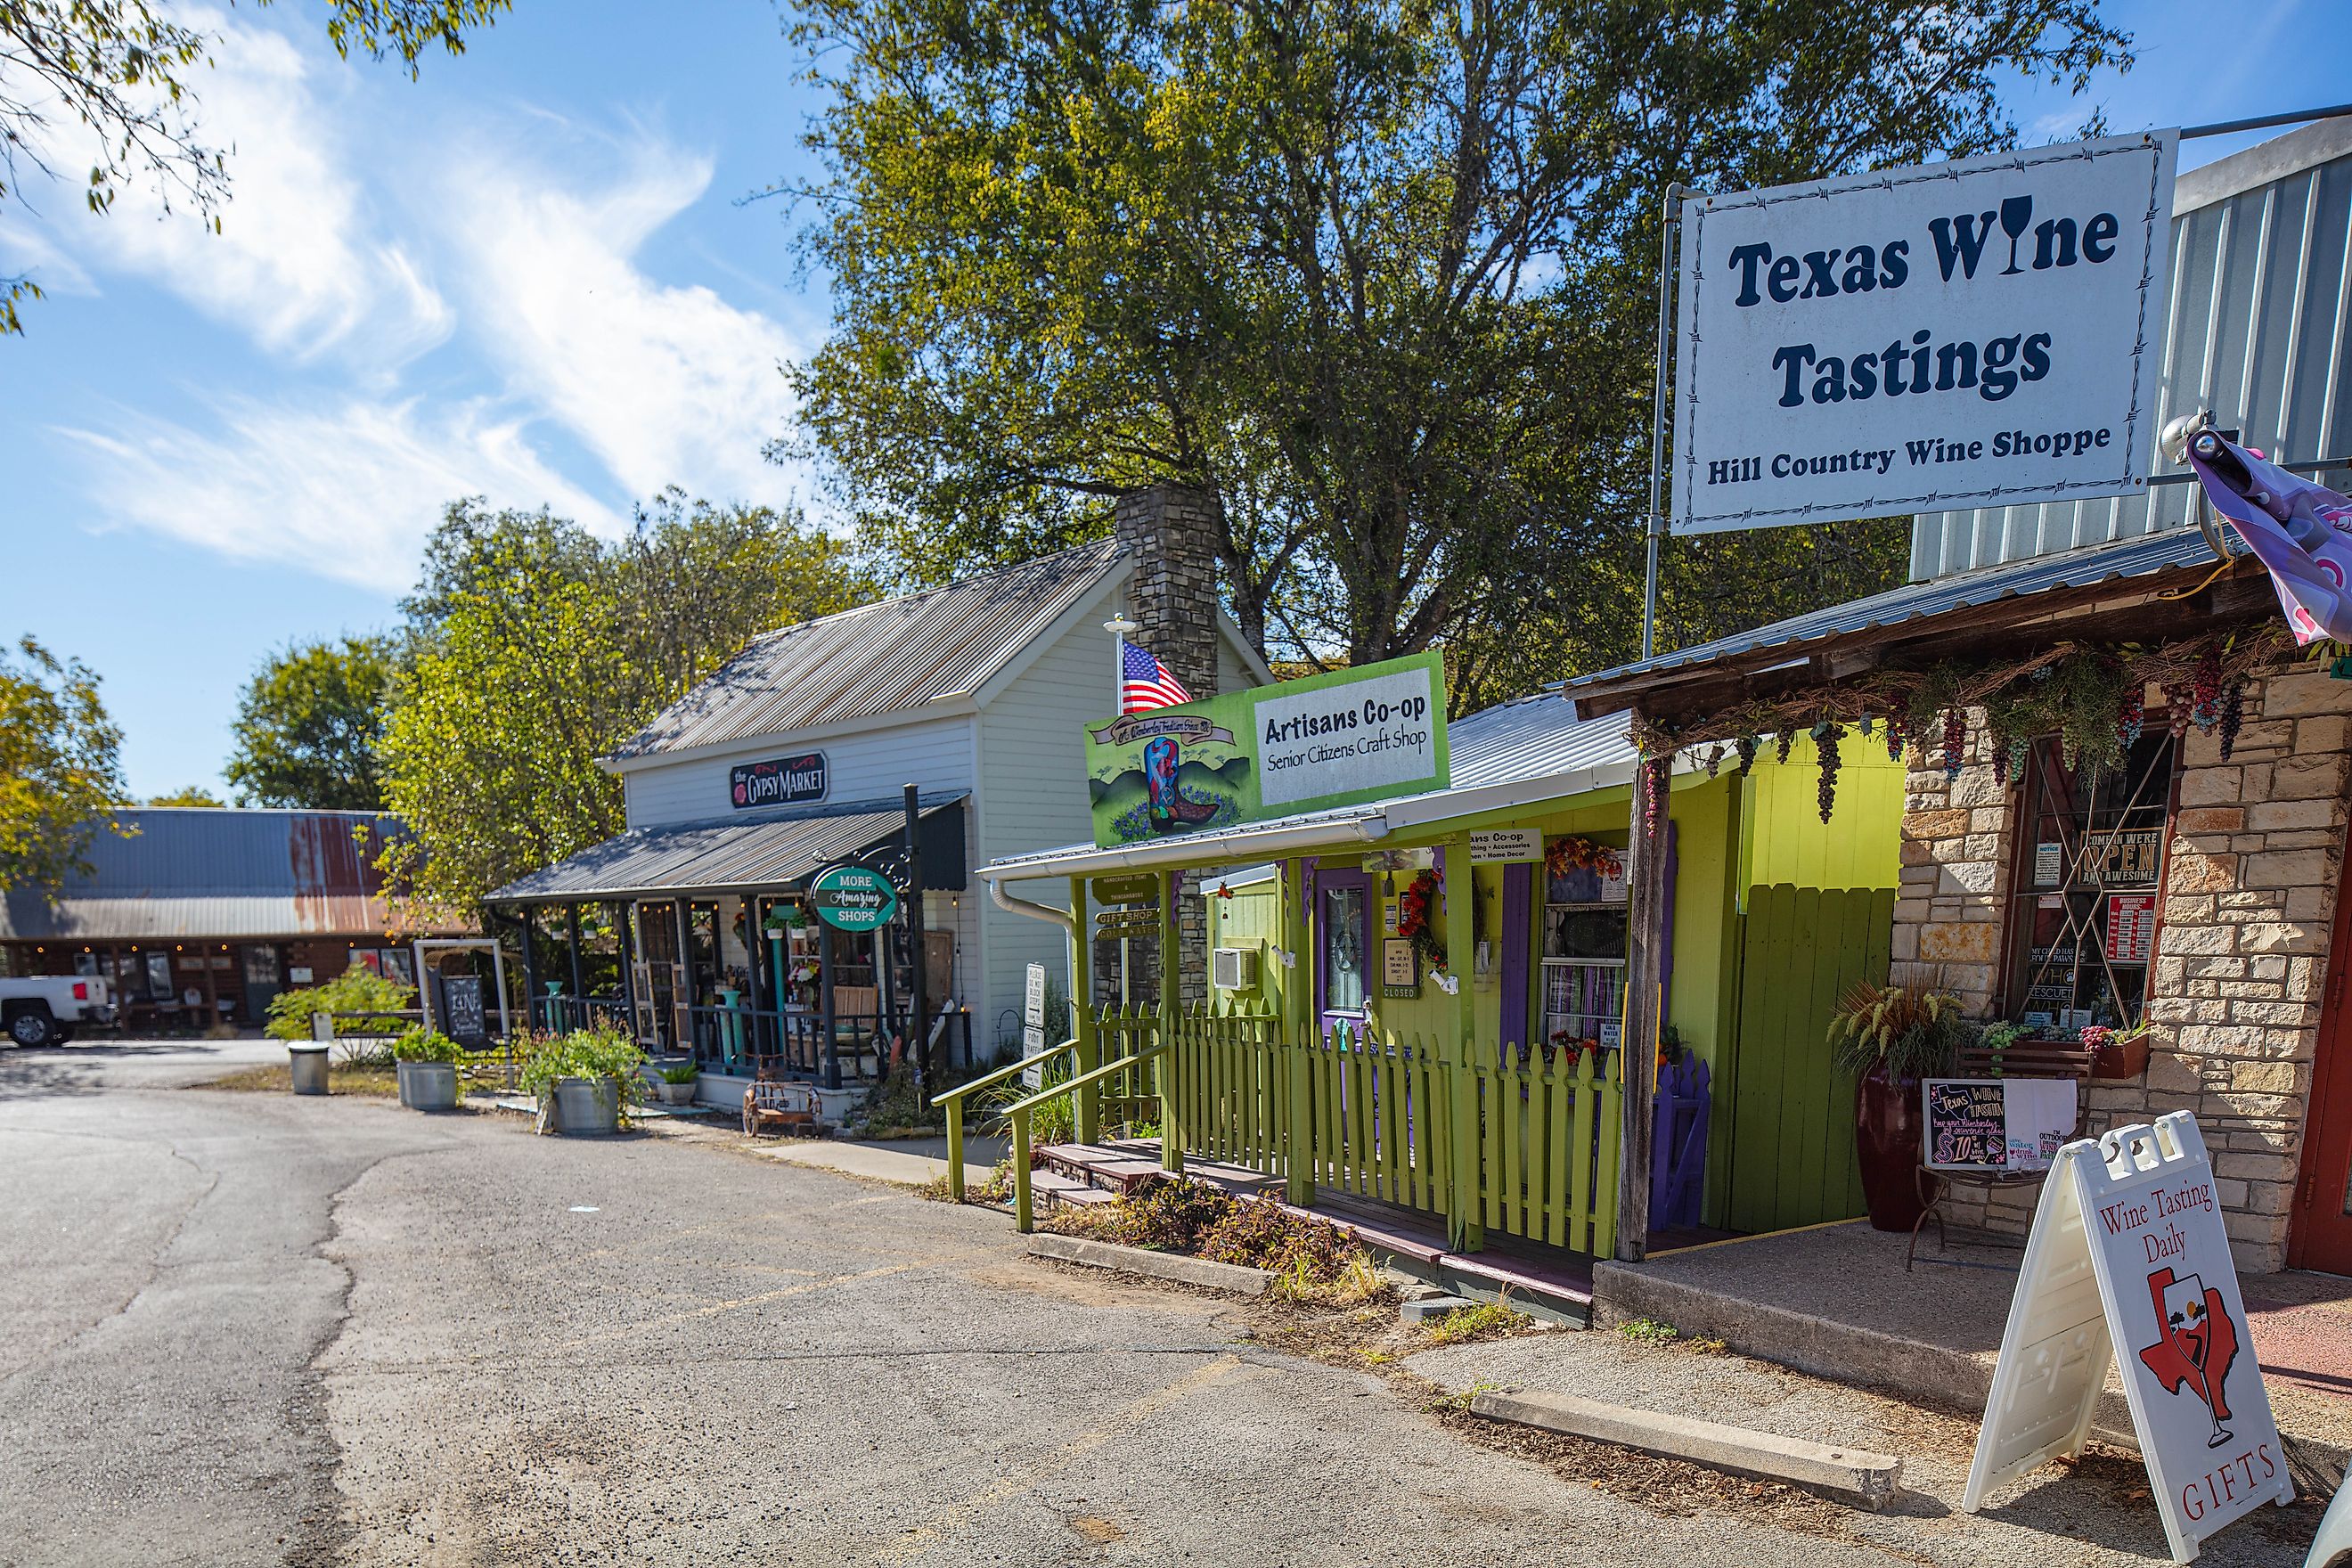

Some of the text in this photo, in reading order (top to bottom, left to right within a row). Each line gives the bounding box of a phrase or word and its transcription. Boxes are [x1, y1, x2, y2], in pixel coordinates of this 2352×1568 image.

[1728, 240, 1909, 307] Texas
[1772, 329, 2051, 407] Tastings
[1708, 428, 2111, 485] Hill Country Wine Shoppe
[1265, 696, 1425, 745] Artisans Co-op
[1267, 723, 1427, 772] Senior Citizens Craft Shop
[734, 771, 747, 783] the
[747, 769, 824, 804] GYPSY MARKET
[1492, 832, 1524, 842] Co-op
[2126, 832, 2158, 844] WE'RE
[1492, 842, 1531, 850] Accessories
[2084, 843, 2156, 872] OPEN
[839, 875, 872, 886] MORE
[2104, 870, 2154, 882] AWESOME
[829, 889, 882, 909] Amazing
[838, 911, 875, 922] SHOPS
[1099, 911, 1153, 923] GIFT SHOP
[1099, 926, 1159, 939] COLD WATER
[1384, 989, 1414, 998] CLOSED
[1121, 1019, 1146, 1028] EXIT
[1971, 1086, 2004, 1102] WINE
[1940, 1095, 1968, 1109] Texas
[2099, 1179, 2213, 1236] Wine Tasting
[2142, 1221, 2185, 1263] Daily
[2182, 1443, 2274, 1521] GIFTS
